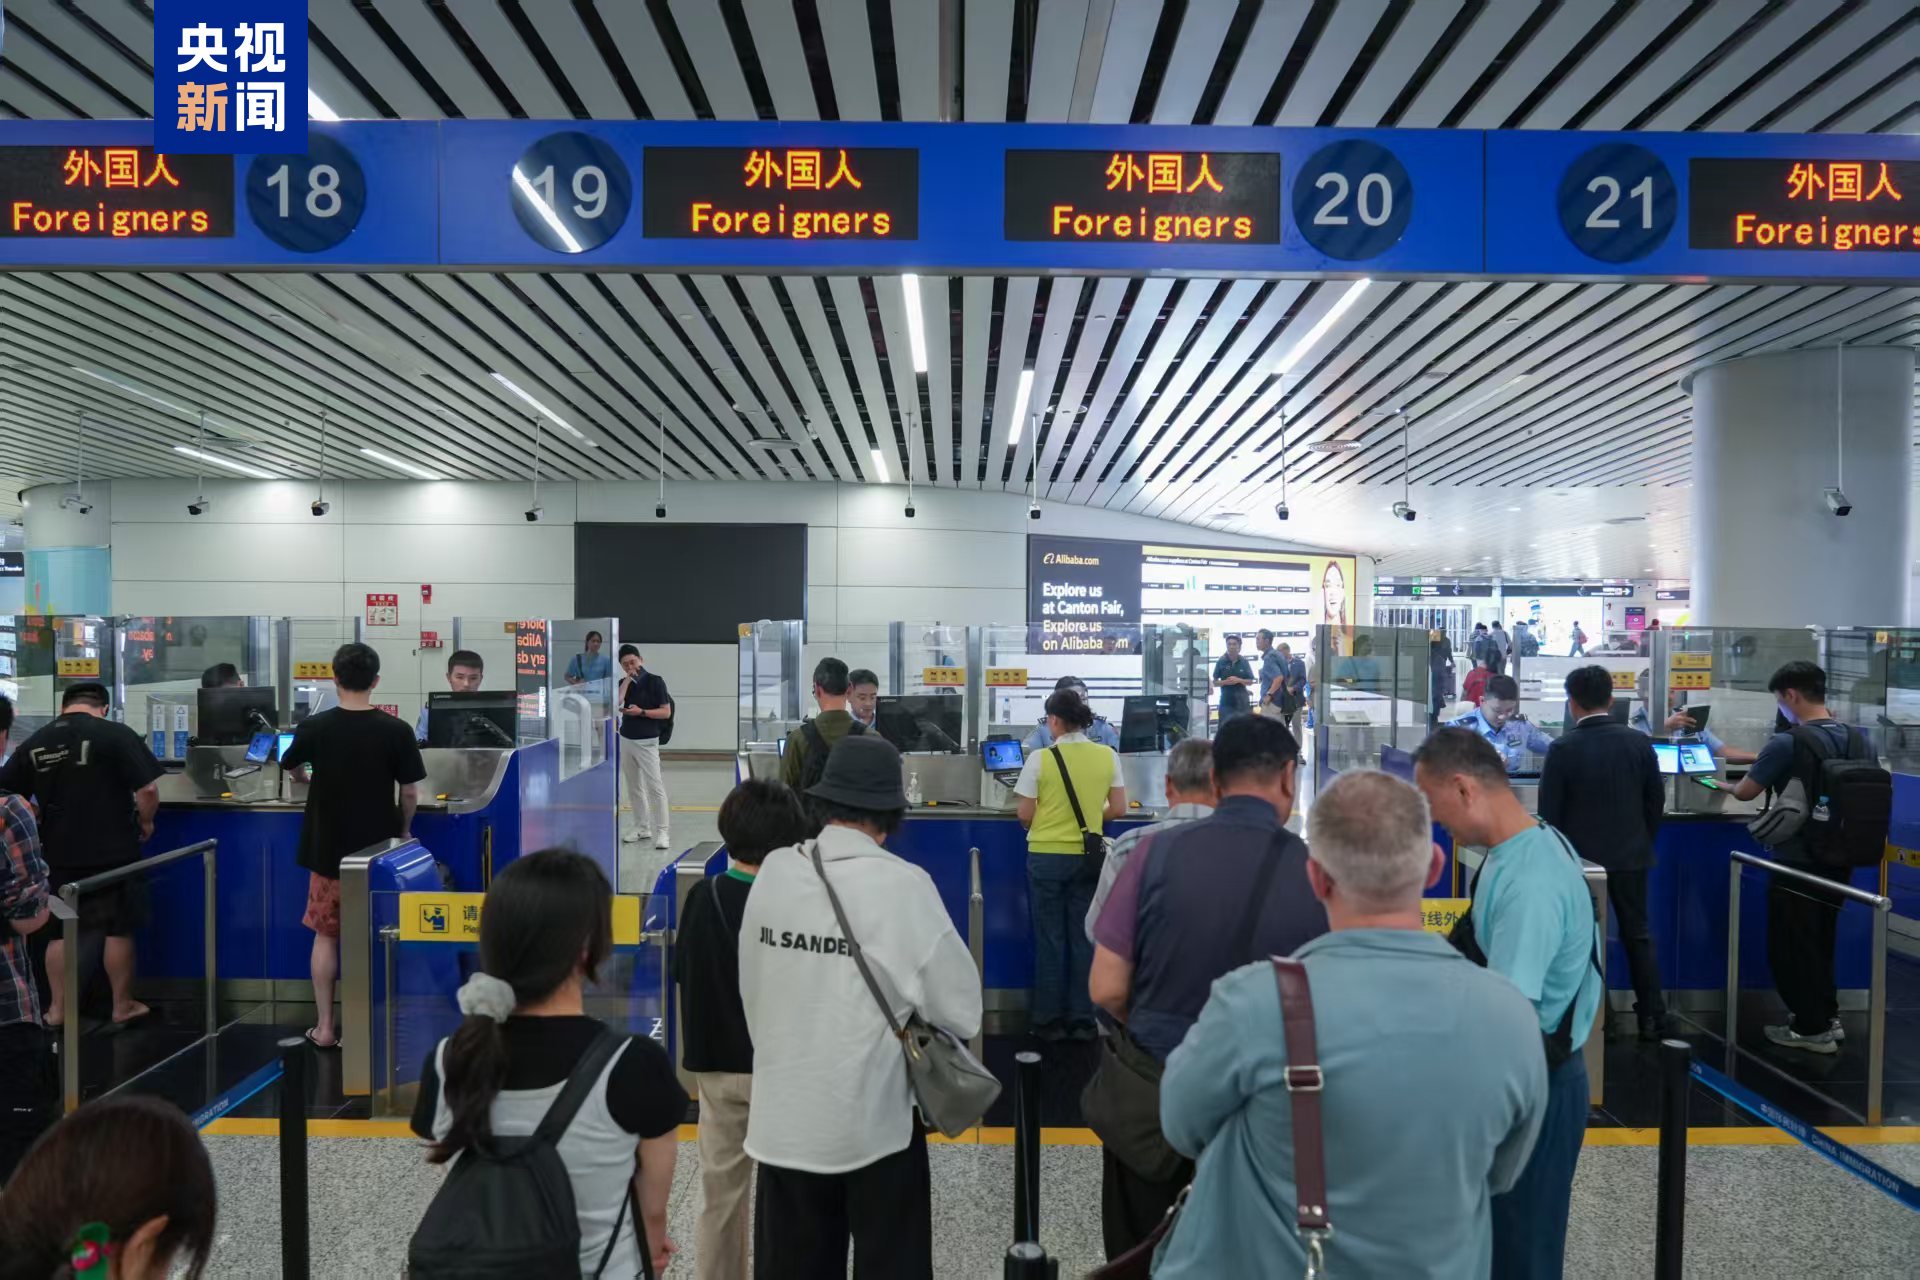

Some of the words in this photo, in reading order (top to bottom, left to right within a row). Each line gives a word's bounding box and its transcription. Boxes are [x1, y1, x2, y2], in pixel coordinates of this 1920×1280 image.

[63, 149, 180, 188] 外国人
[743, 150, 862, 190] 外国人
[1105, 153, 1225, 193] 外国人
[1786, 162, 1902, 202] 外国人
[266, 164, 342, 218] 18
[534, 165, 609, 219] 19
[1313, 172, 1394, 227] 20
[1585, 176, 1654, 229] 21
[12, 202, 209, 237] Foreigners
[691, 203, 890, 238] Foreigners
[1053, 206, 1252, 242] Foreigners
[1055, 554, 1100, 565] Alibaba.com
[1042, 582, 1086, 600] Explore
[1088, 586, 1103, 597] us
[1042, 601, 1055, 615] at
[1057, 600, 1099, 615] Canton
[1101, 600, 1124, 617] Fair,
[1042, 639, 1058, 650] on
[1043, 619, 1087, 636] Explore
[1089, 622, 1102, 632] us
[1420, 911, 1466, 926] 线外
[760, 926, 777, 947] JIL
